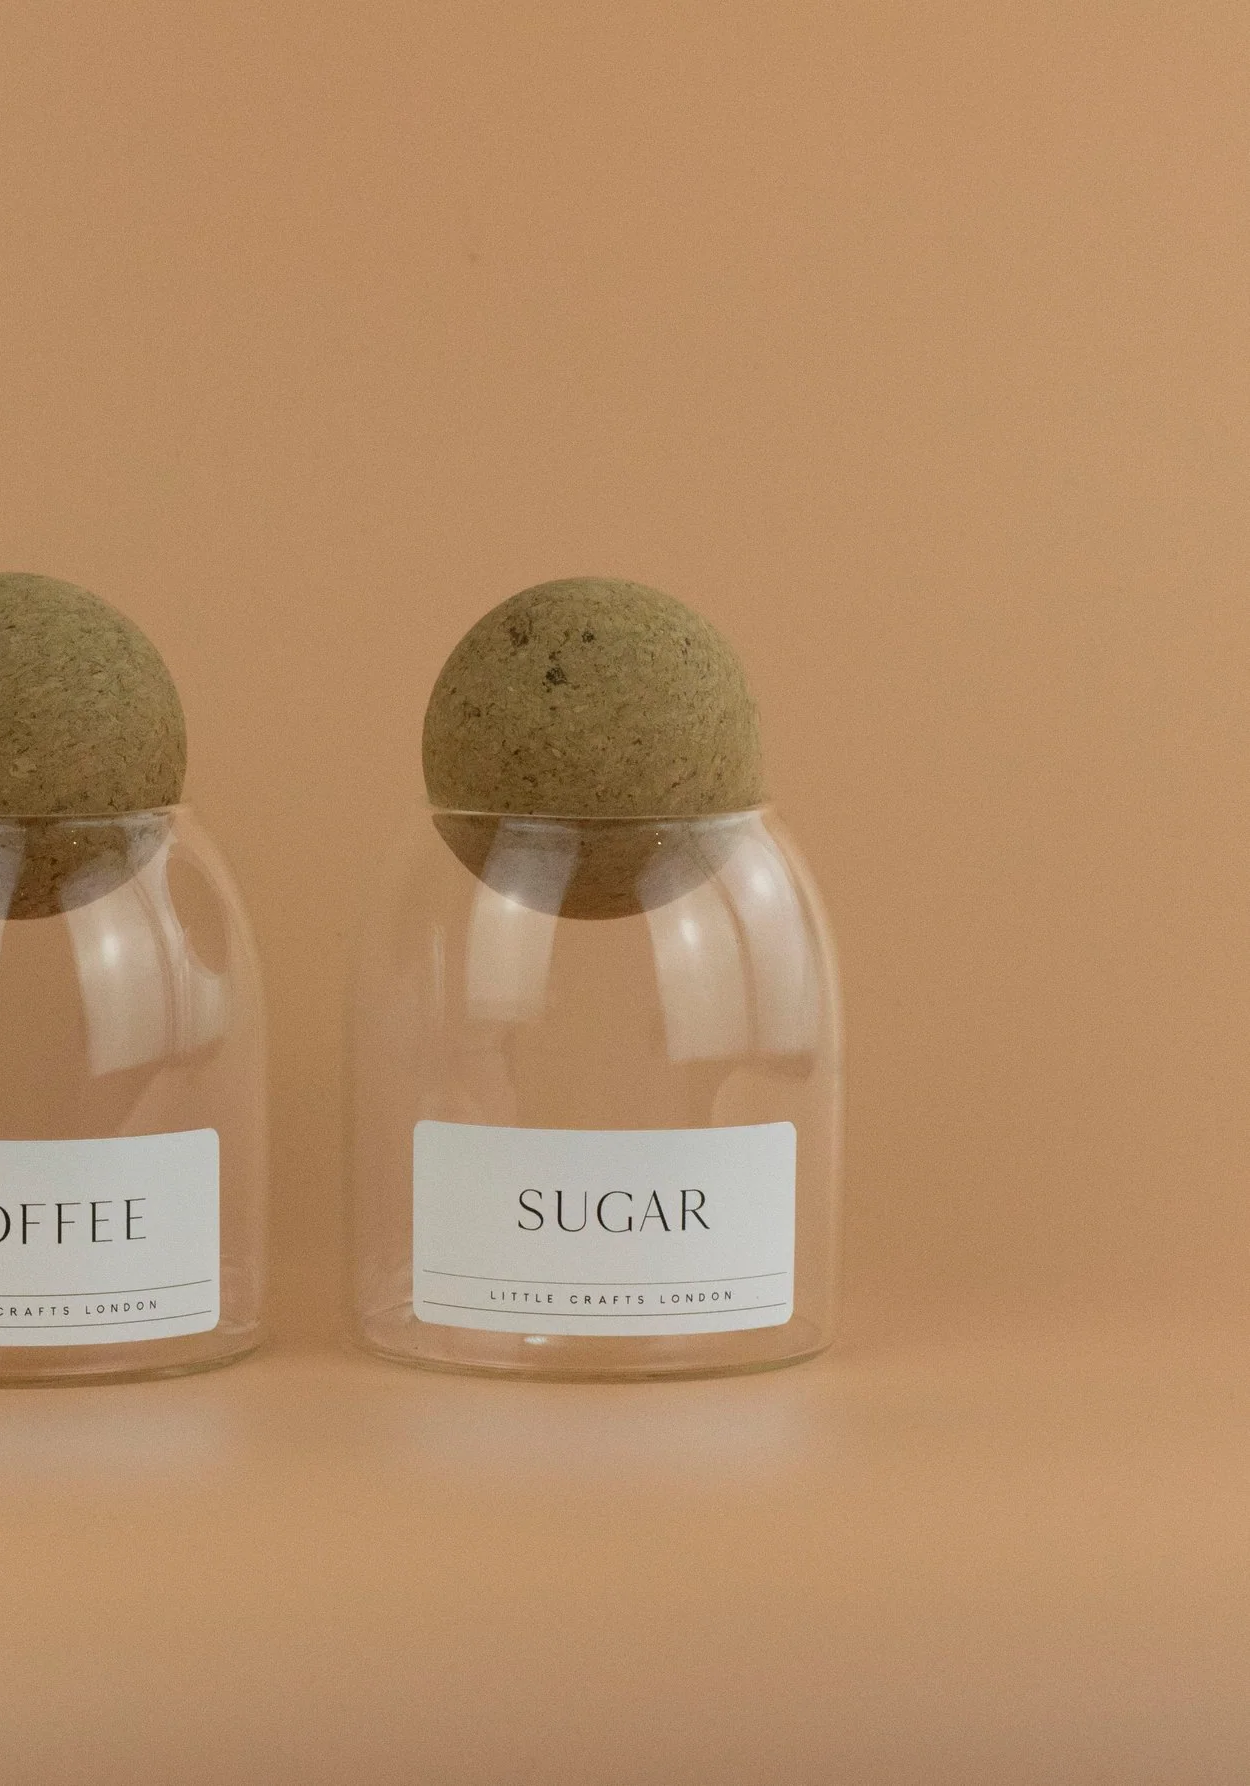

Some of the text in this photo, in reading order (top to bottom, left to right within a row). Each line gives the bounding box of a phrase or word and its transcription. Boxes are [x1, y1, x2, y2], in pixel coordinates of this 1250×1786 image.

[517, 1188, 711, 1234] SUGAR
[490, 1290, 733, 1305] LITTLE CRAFTS LONDON
[85, 1300, 158, 1315] LONDON
